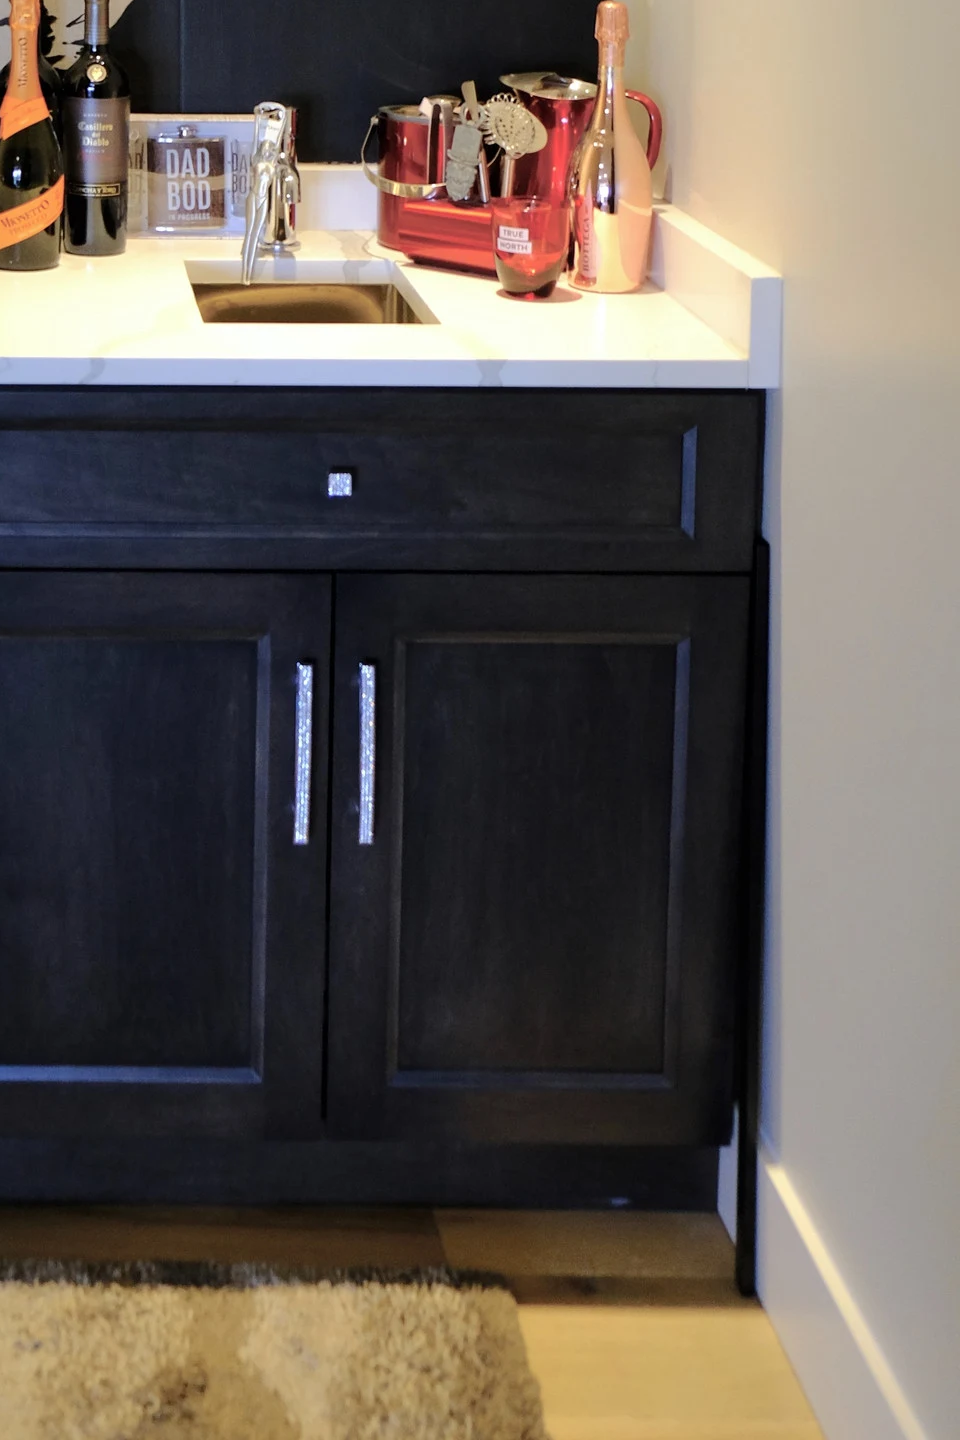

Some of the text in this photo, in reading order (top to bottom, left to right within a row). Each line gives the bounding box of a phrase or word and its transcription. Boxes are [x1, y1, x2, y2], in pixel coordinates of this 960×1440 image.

[78, 121, 113, 131] Casillero
[82, 135, 110, 147] Diablo
[166, 147, 210, 179] DAD
[167, 180, 211, 211] BOD
[503, 228, 525, 238] TRUE
